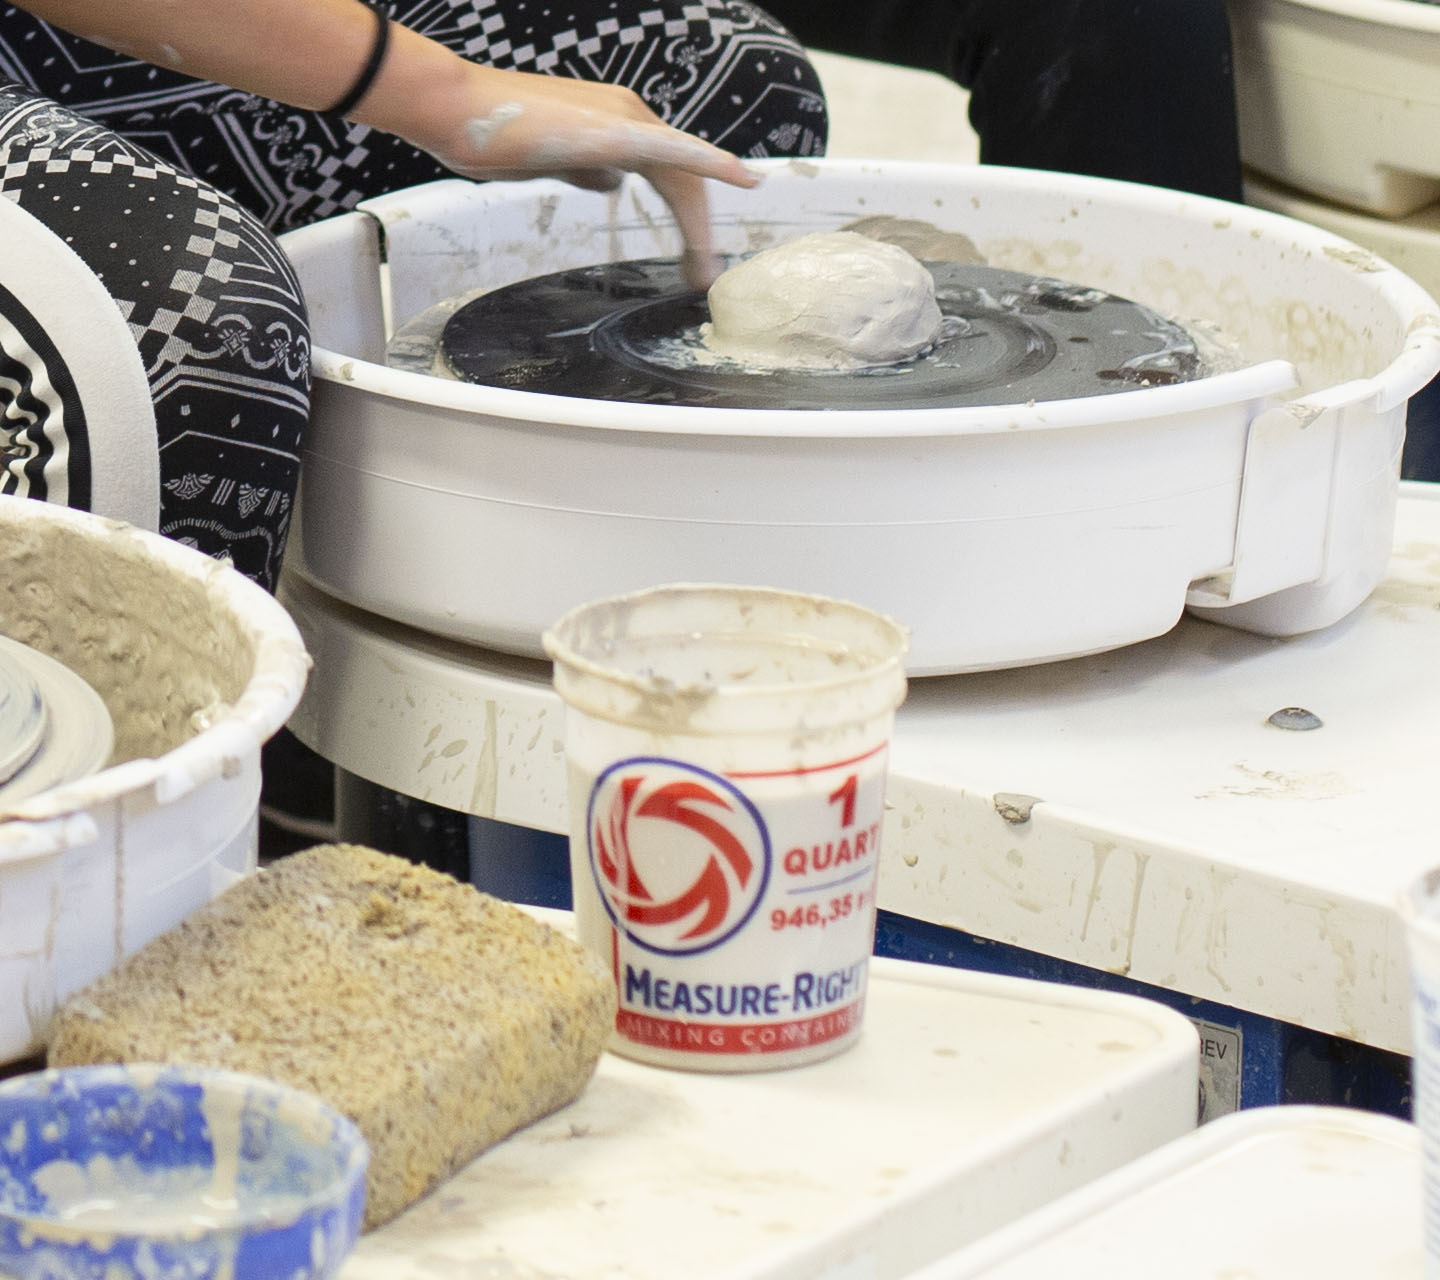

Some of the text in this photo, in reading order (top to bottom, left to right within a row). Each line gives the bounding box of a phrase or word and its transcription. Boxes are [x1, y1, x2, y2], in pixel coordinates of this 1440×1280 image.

[828, 774, 859, 829] 1
[783, 822, 879, 877] QUART
[770, 893, 853, 931] 946,35
[625, 1017, 725, 1047] MIXING
